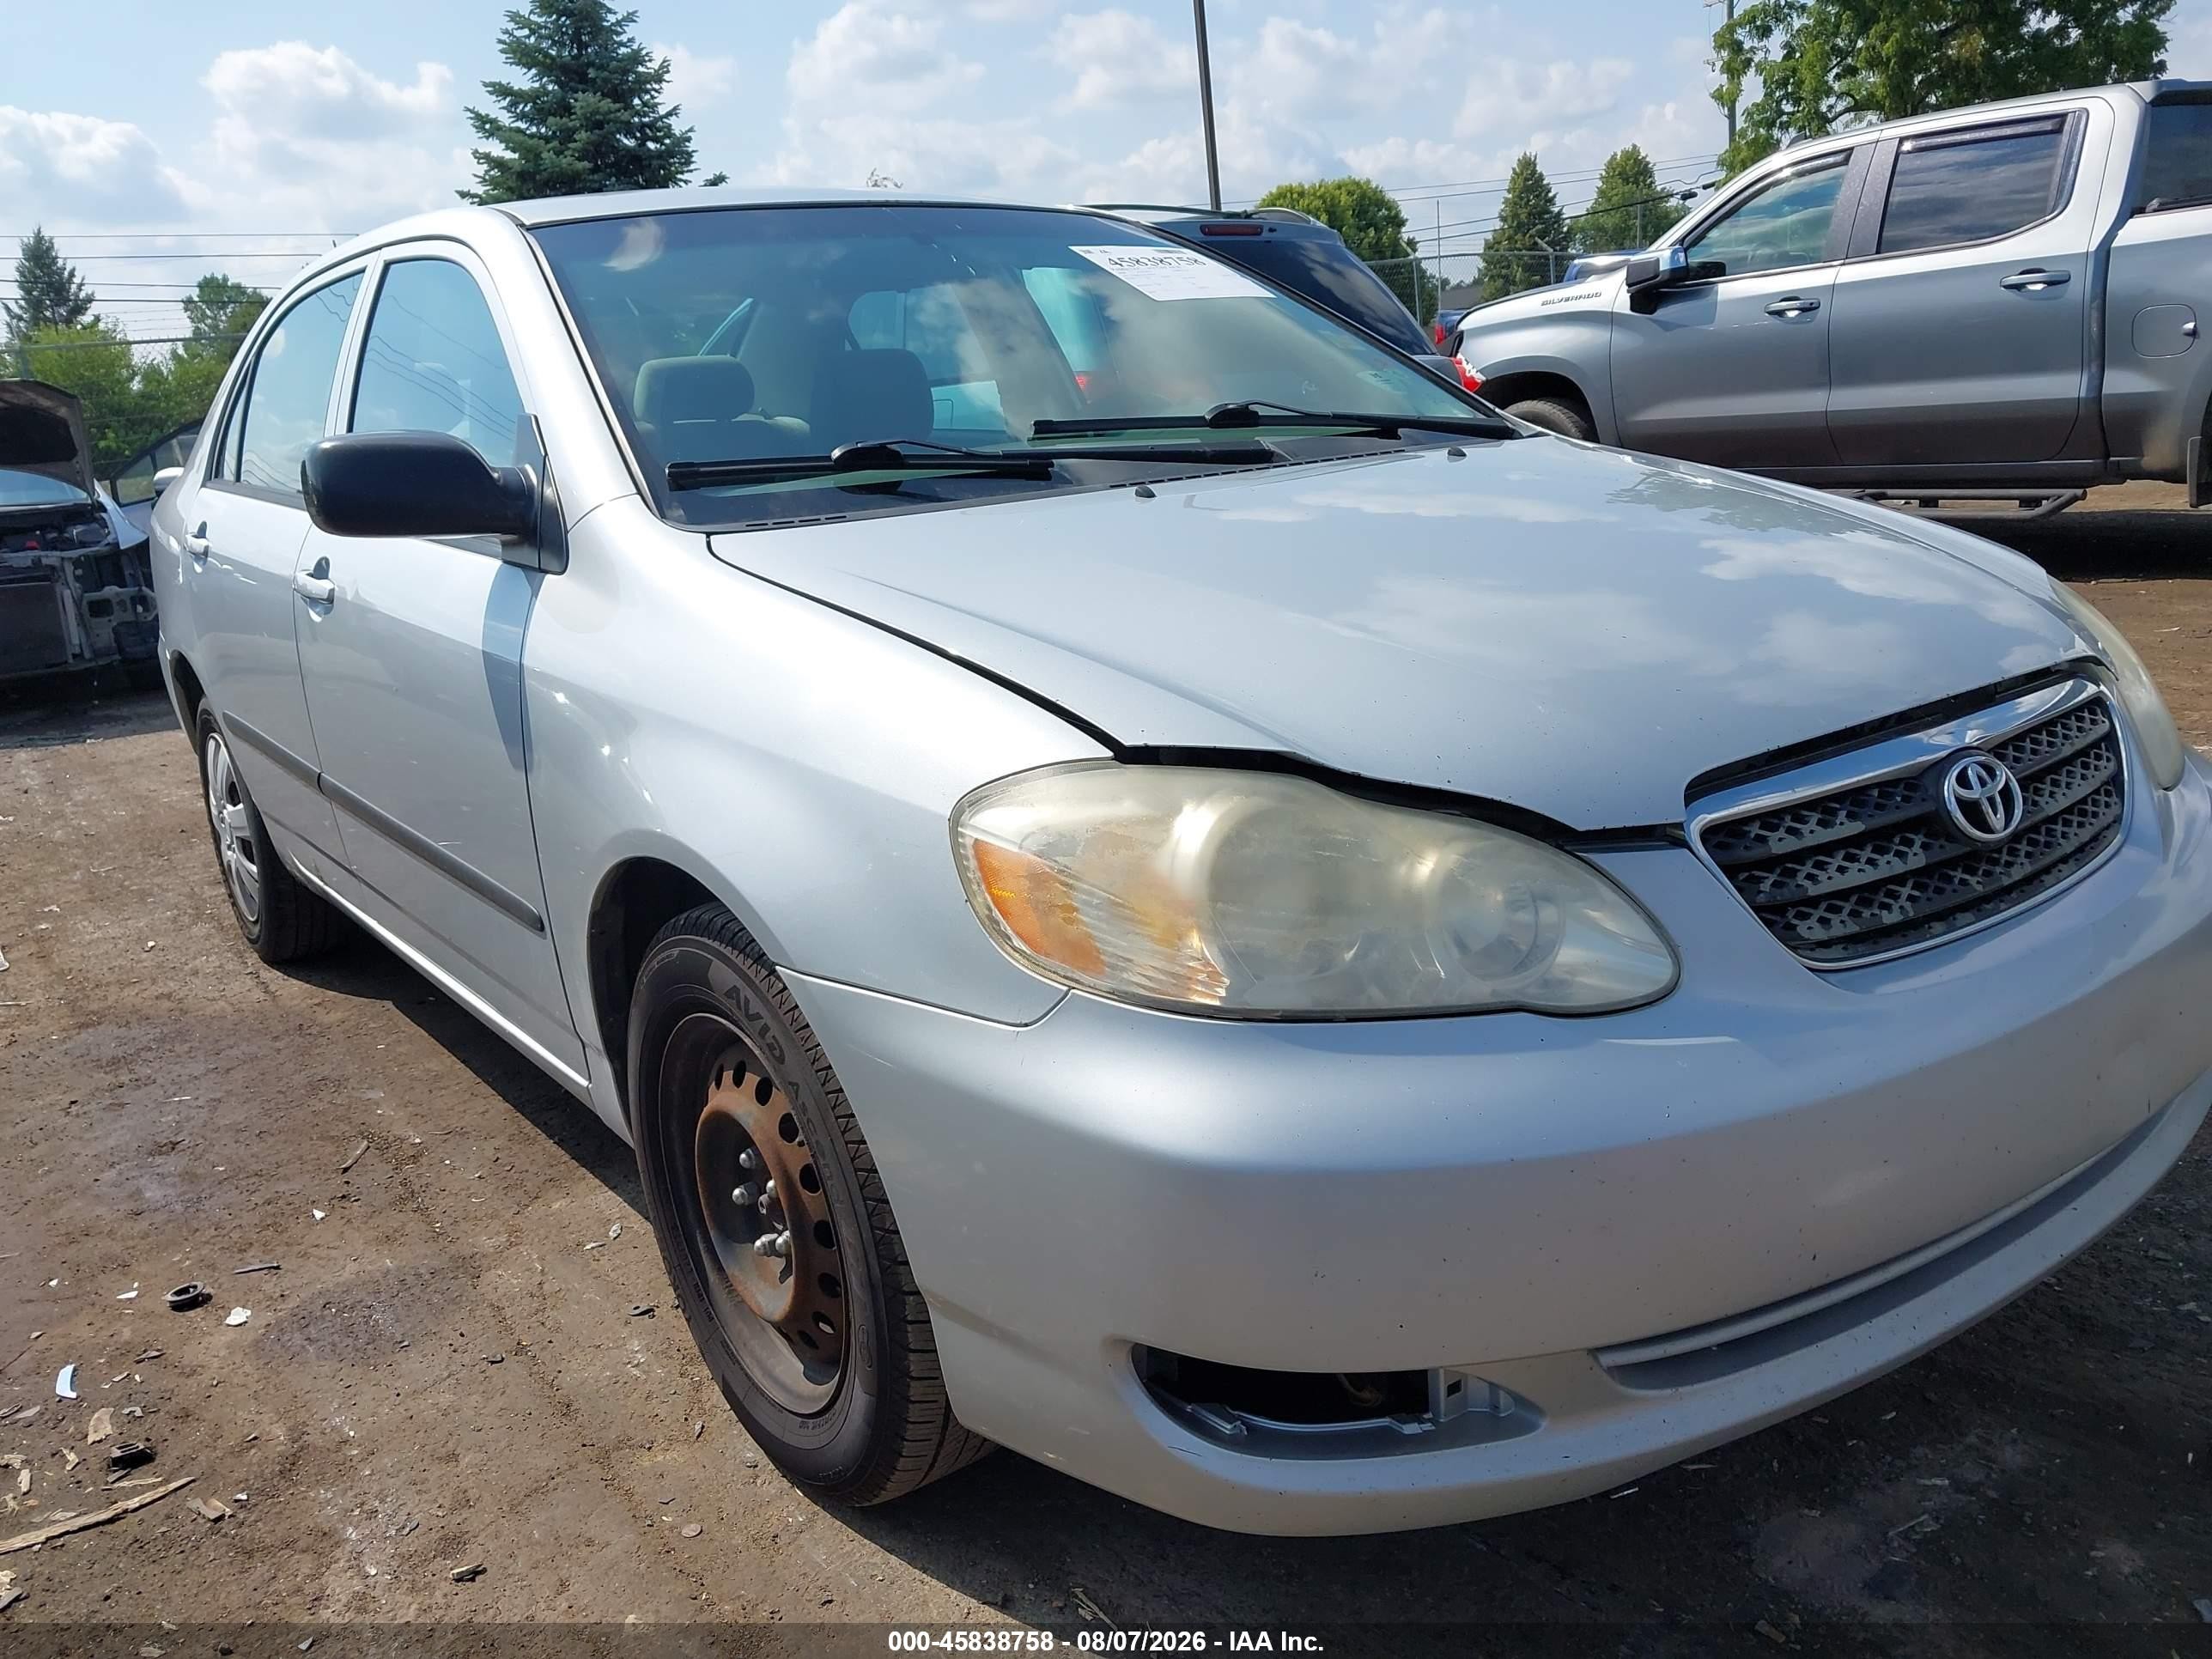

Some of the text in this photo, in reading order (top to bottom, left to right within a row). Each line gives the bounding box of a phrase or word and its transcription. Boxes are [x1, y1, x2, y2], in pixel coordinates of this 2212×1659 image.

[1108, 257, 1206, 267] 45838758
[1540, 291, 1602, 307] SILVERADO
[724, 984, 787, 1066] AVID
